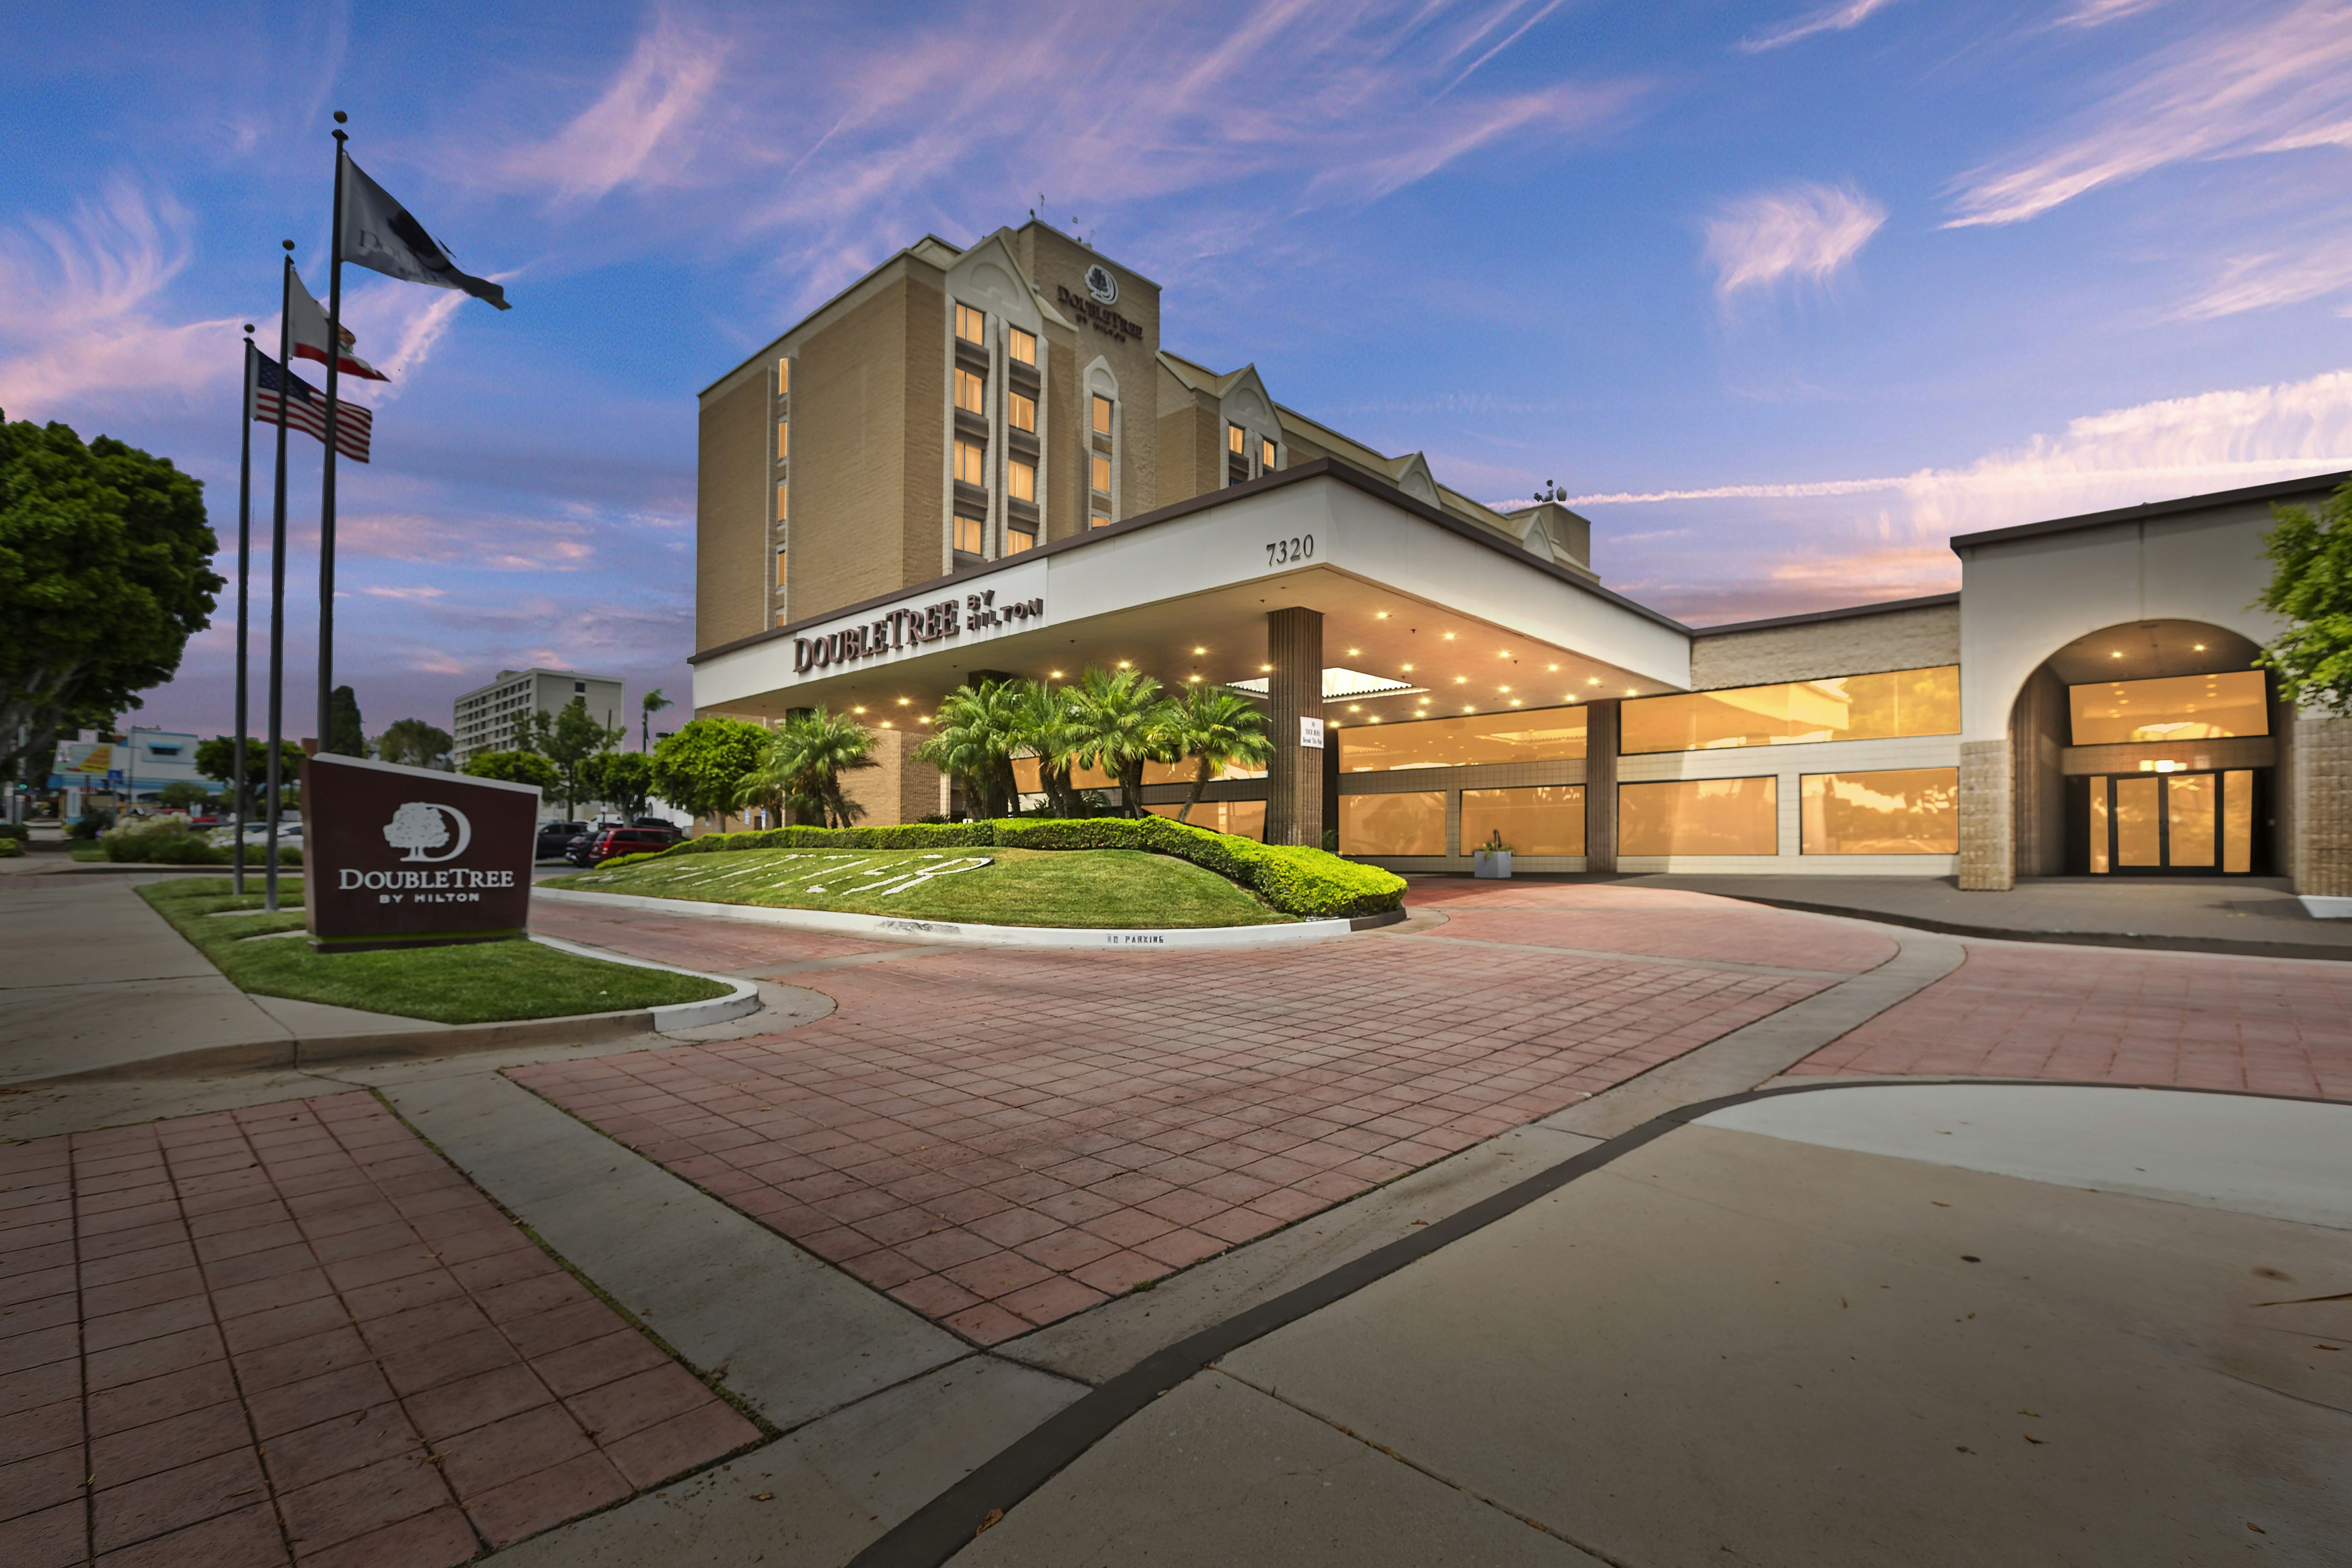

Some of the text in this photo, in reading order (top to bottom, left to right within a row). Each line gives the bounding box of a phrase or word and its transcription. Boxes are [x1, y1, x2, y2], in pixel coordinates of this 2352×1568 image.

[1266, 534, 1314, 567] 7320
[967, 590, 995, 610] BY
[966, 598, 1043, 630] HILTON
[793, 600, 960, 673] DOUBLETREE
[339, 868, 515, 890] DOUBLETREE
[379, 893, 479, 904] BY HILTON
